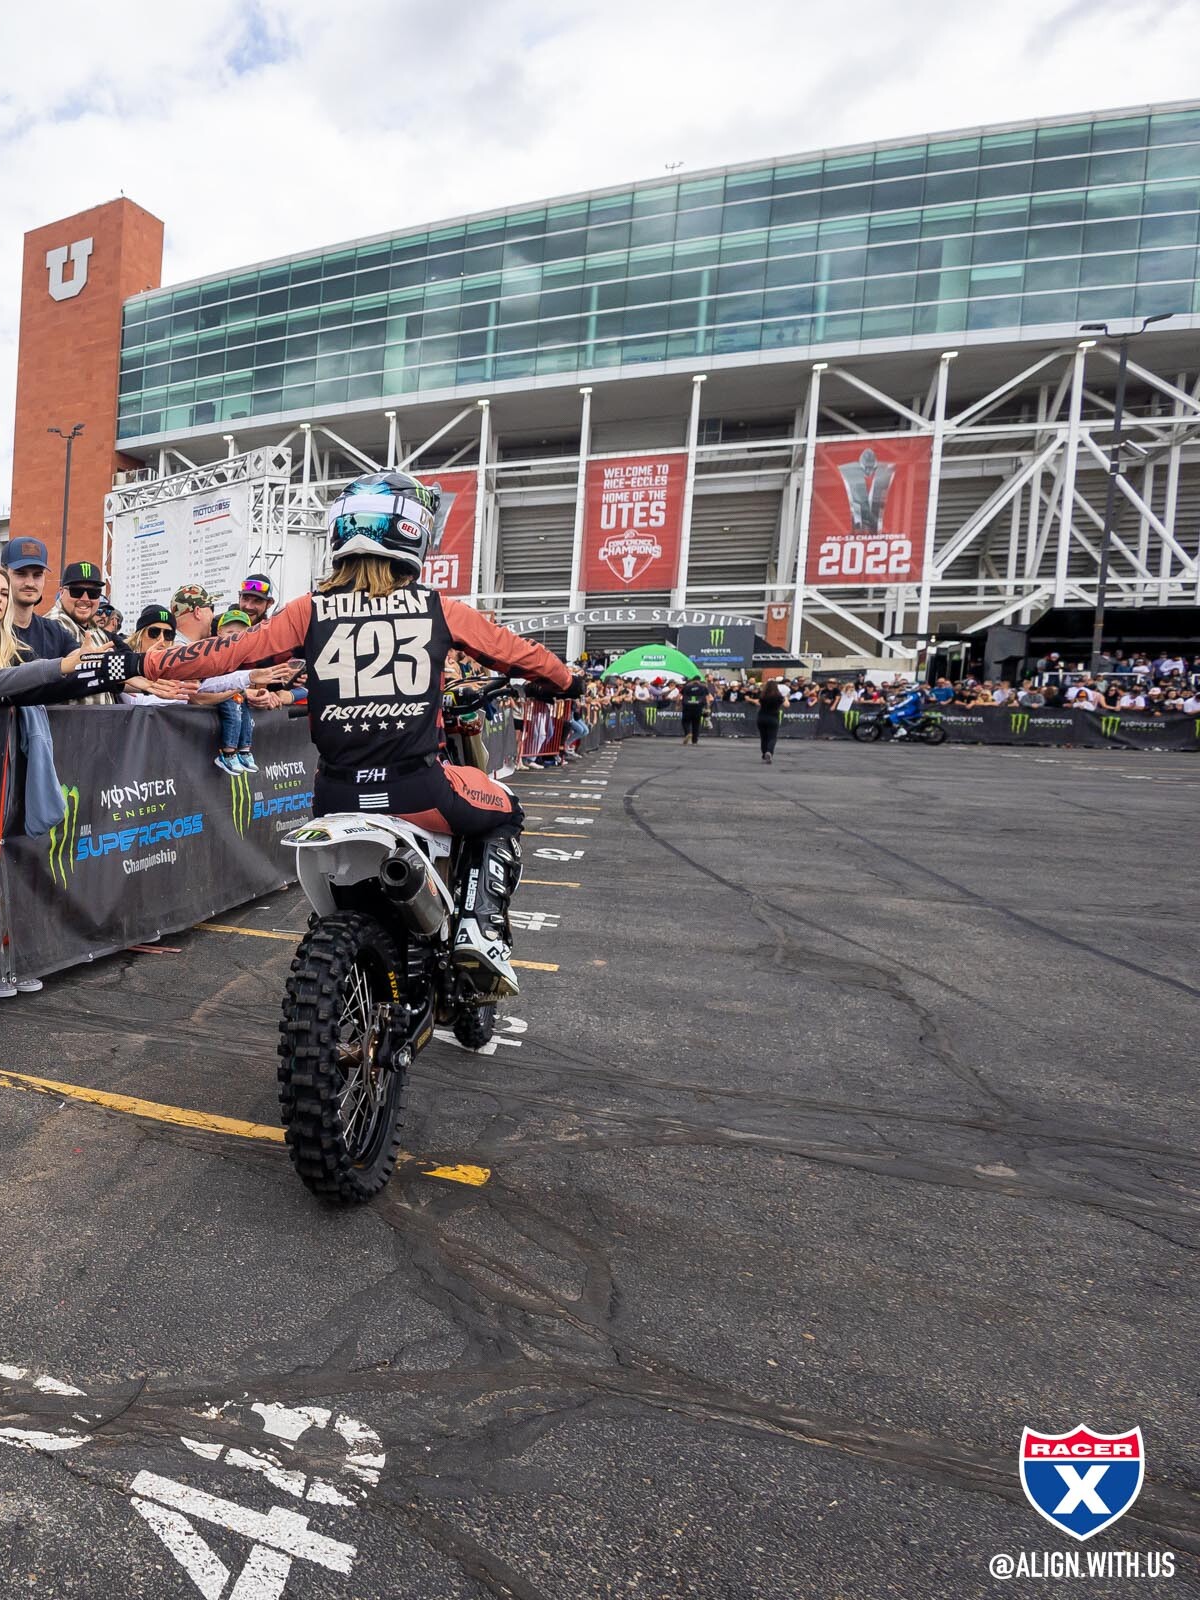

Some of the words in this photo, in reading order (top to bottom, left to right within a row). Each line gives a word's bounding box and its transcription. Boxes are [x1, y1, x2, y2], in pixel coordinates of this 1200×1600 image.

[46, 237, 93, 301] U
[604, 465, 653, 479] WELCOME
[656, 464, 669, 475] TO
[603, 476, 668, 490] RICE-ECCLES
[602, 492, 630, 503] HOME
[633, 491, 645, 502] OF
[648, 490, 667, 501] THE
[600, 501, 666, 530] UTES
[402, 523, 418, 537] BELL
[856, 533, 906, 541] CHAMPIONS
[425, 553, 459, 561] HAMPIONS
[599, 545, 662, 560] CHAMPIONS
[818, 540, 912, 576] 2022
[418, 560, 459, 589] 021
[312, 589, 430, 622] GOLDEN
[506, 609, 637, 633] RICE-ECCLES
[314, 618, 433, 699] 423
[320, 702, 430, 721] FASTHOUSE
[657, 711, 682, 719] MONSTE
[265, 761, 306, 780] MONSTER
[101, 779, 176, 809] MONSTER
[274, 780, 302, 790] ENERGY
[113, 803, 166, 821] ENERGY
[252, 791, 314, 819] SUPERCRO
[76, 813, 203, 860] SUPERCROSS
[387, 971, 400, 1004] DUN
